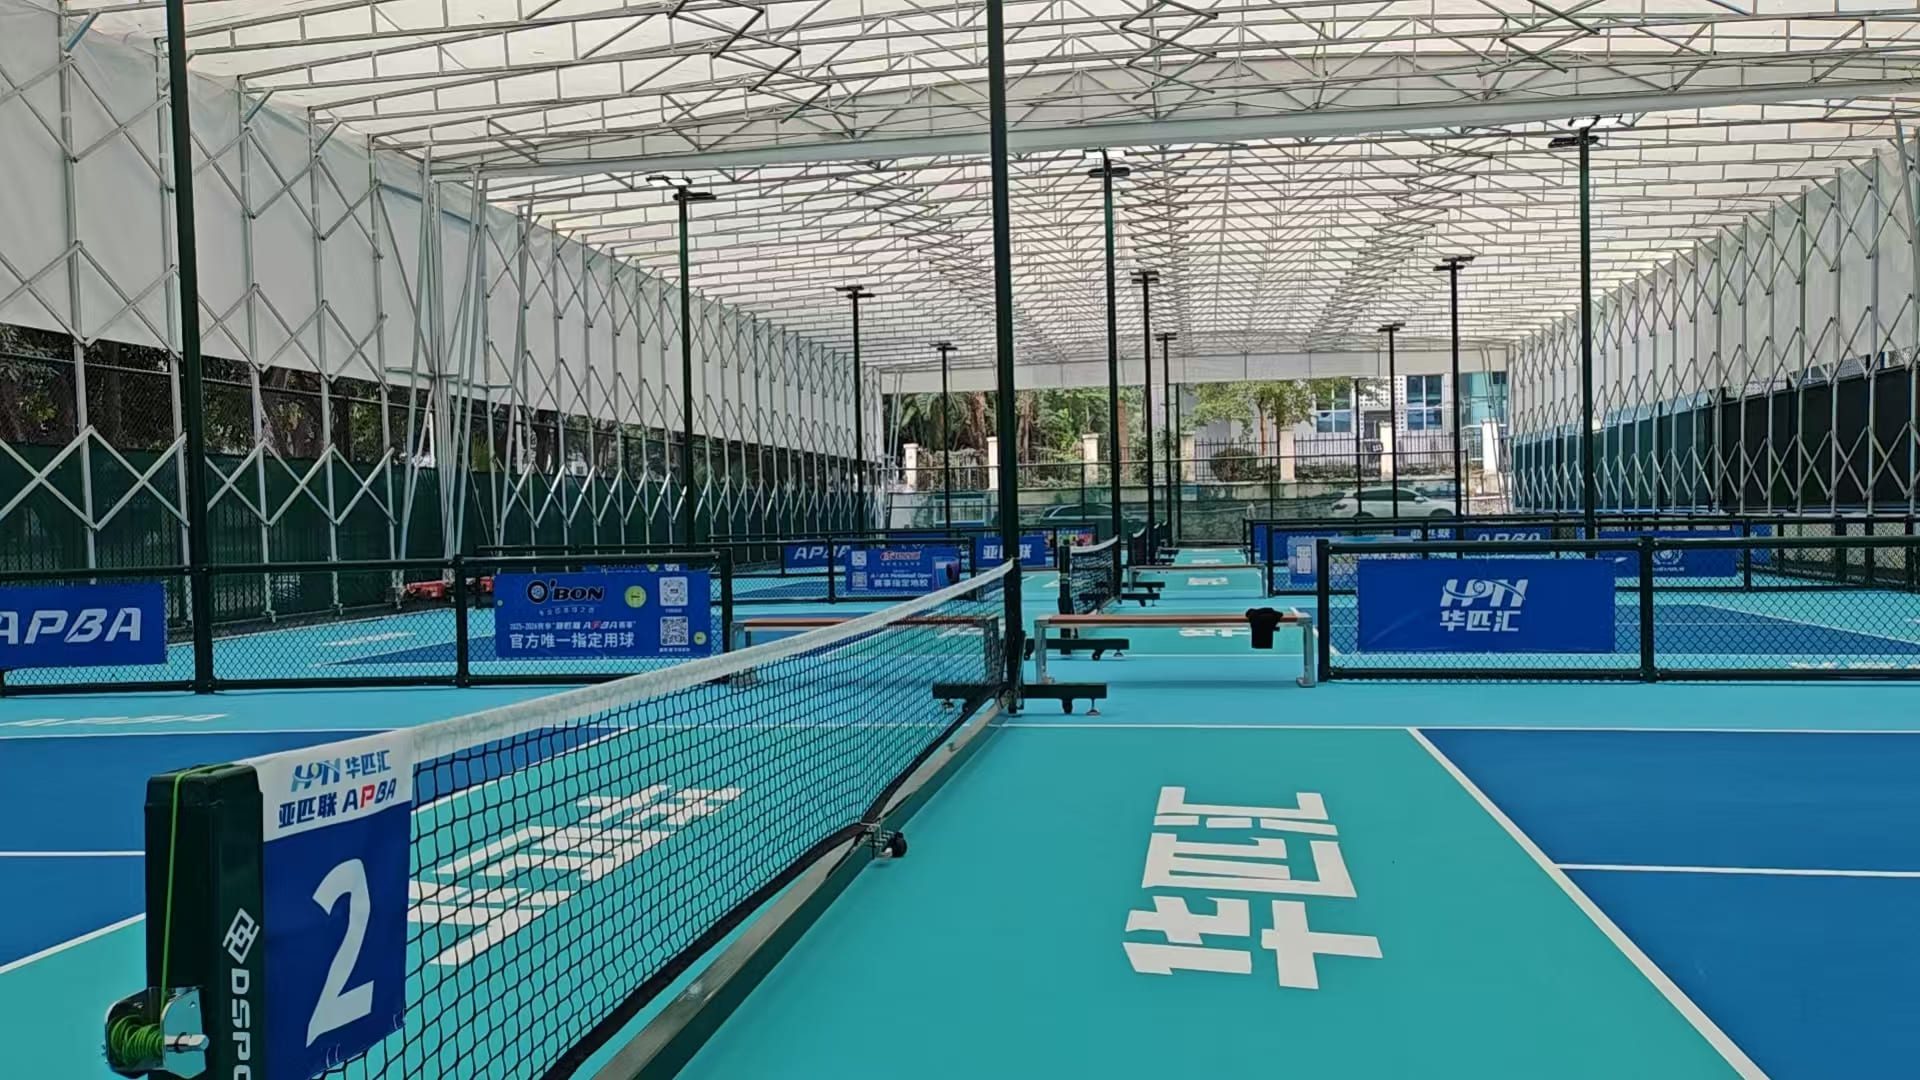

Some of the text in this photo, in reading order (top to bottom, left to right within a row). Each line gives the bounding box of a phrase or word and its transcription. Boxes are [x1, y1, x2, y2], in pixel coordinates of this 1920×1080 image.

[982, 544, 1032, 560] 亚联
[1440, 609, 1521, 632] 华匹汇
[509, 632, 635, 649] 官方唯一指定用球
[345, 750, 391, 779] 华匹汇
[278, 778, 397, 829] 亚匹联 APBA
[1122, 786, 1384, 990] 华匹汇
[306, 858, 374, 1048] 2
